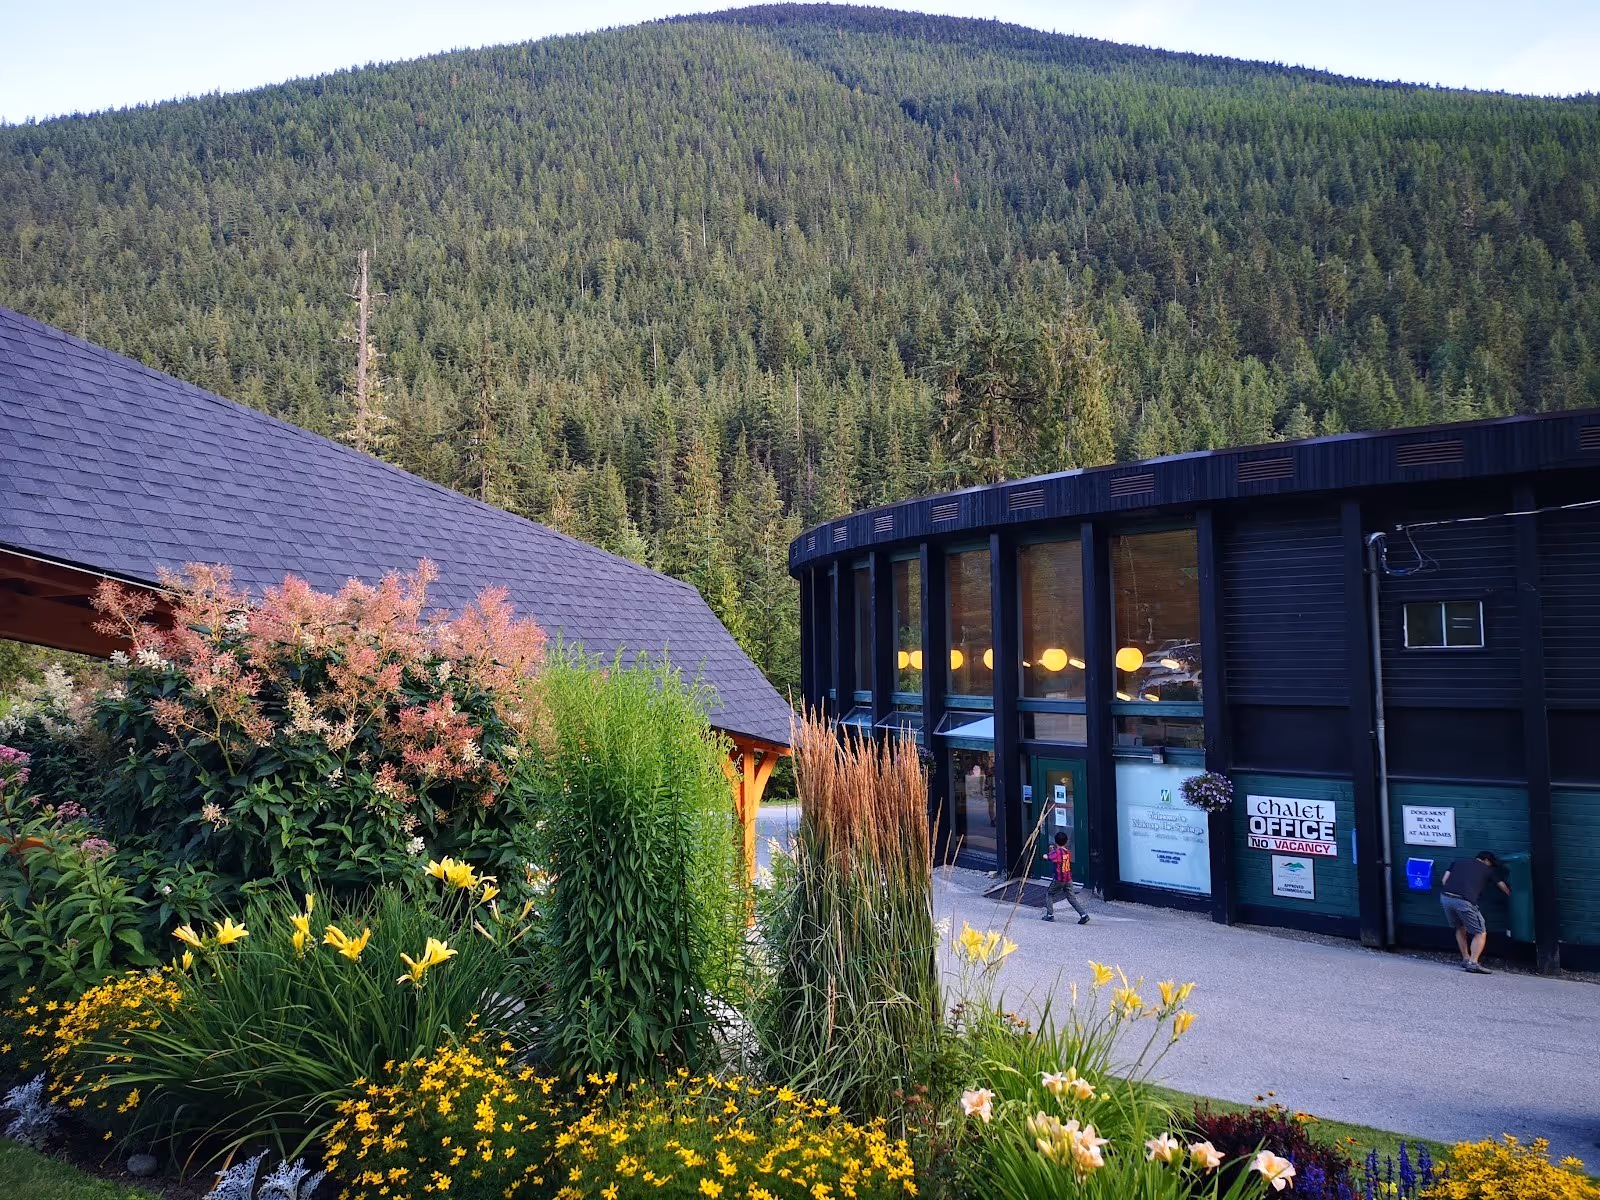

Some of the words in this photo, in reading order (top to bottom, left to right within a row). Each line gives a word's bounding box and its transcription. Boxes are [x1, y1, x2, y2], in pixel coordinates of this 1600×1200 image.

[1257, 799, 1325, 820] chalet
[1249, 816, 1334, 841] OFFICE
[1251, 838, 1269, 849] NO
[1274, 840, 1331, 854] VACANCY
